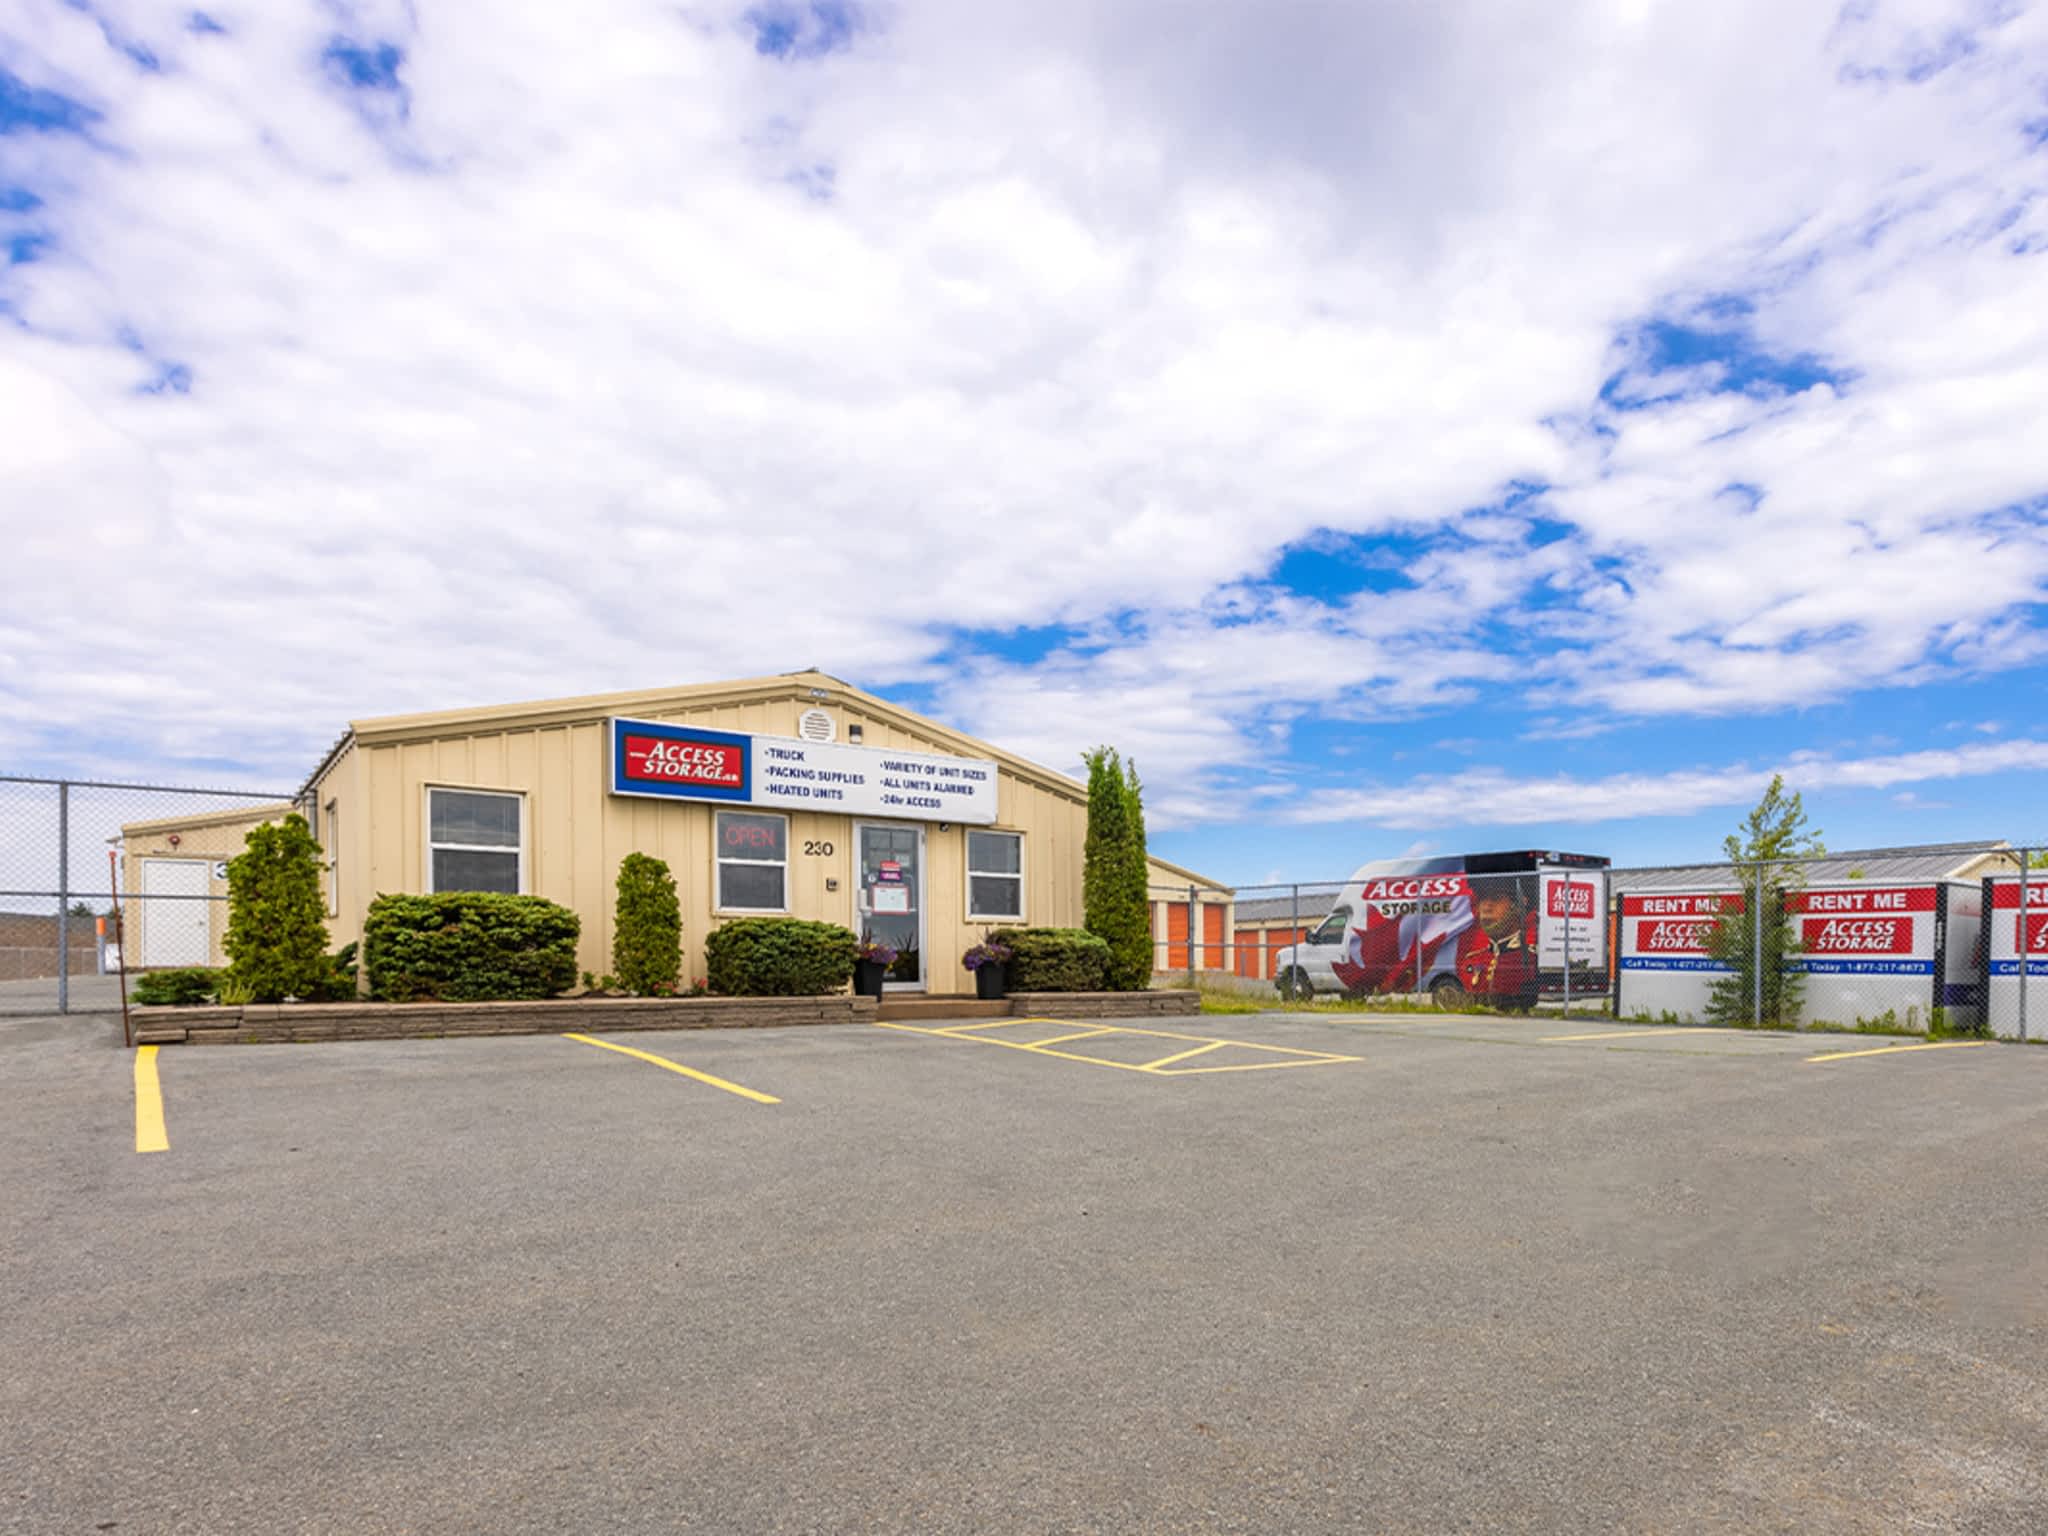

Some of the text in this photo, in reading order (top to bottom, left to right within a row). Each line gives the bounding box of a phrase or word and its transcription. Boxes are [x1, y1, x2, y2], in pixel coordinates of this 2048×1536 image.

[648, 741, 725, 766] ACCESS
[769, 748, 805, 761] TRUCK
[769, 766, 865, 785] PACKING SUPPLIES
[883, 761, 987, 781] VARIETY OF UNIT SIZES
[769, 784, 843, 801] HEATED UNITS
[883, 778, 974, 796] ALL UNITS ALARMED
[906, 796, 942, 809] ACCESS
[725, 825, 776, 848] OPEN
[804, 841, 834, 857] 230
[1368, 878, 1461, 898] ACCESS
[1643, 898, 1721, 912] RENT ME
[1808, 893, 1907, 910] RENT ME
[1652, 921, 1713, 937] ACCESS
[1822, 920, 1897, 937] ACCESS
[1816, 937, 1894, 950] STORAGE
[2000, 964, 2022, 973] Cal
